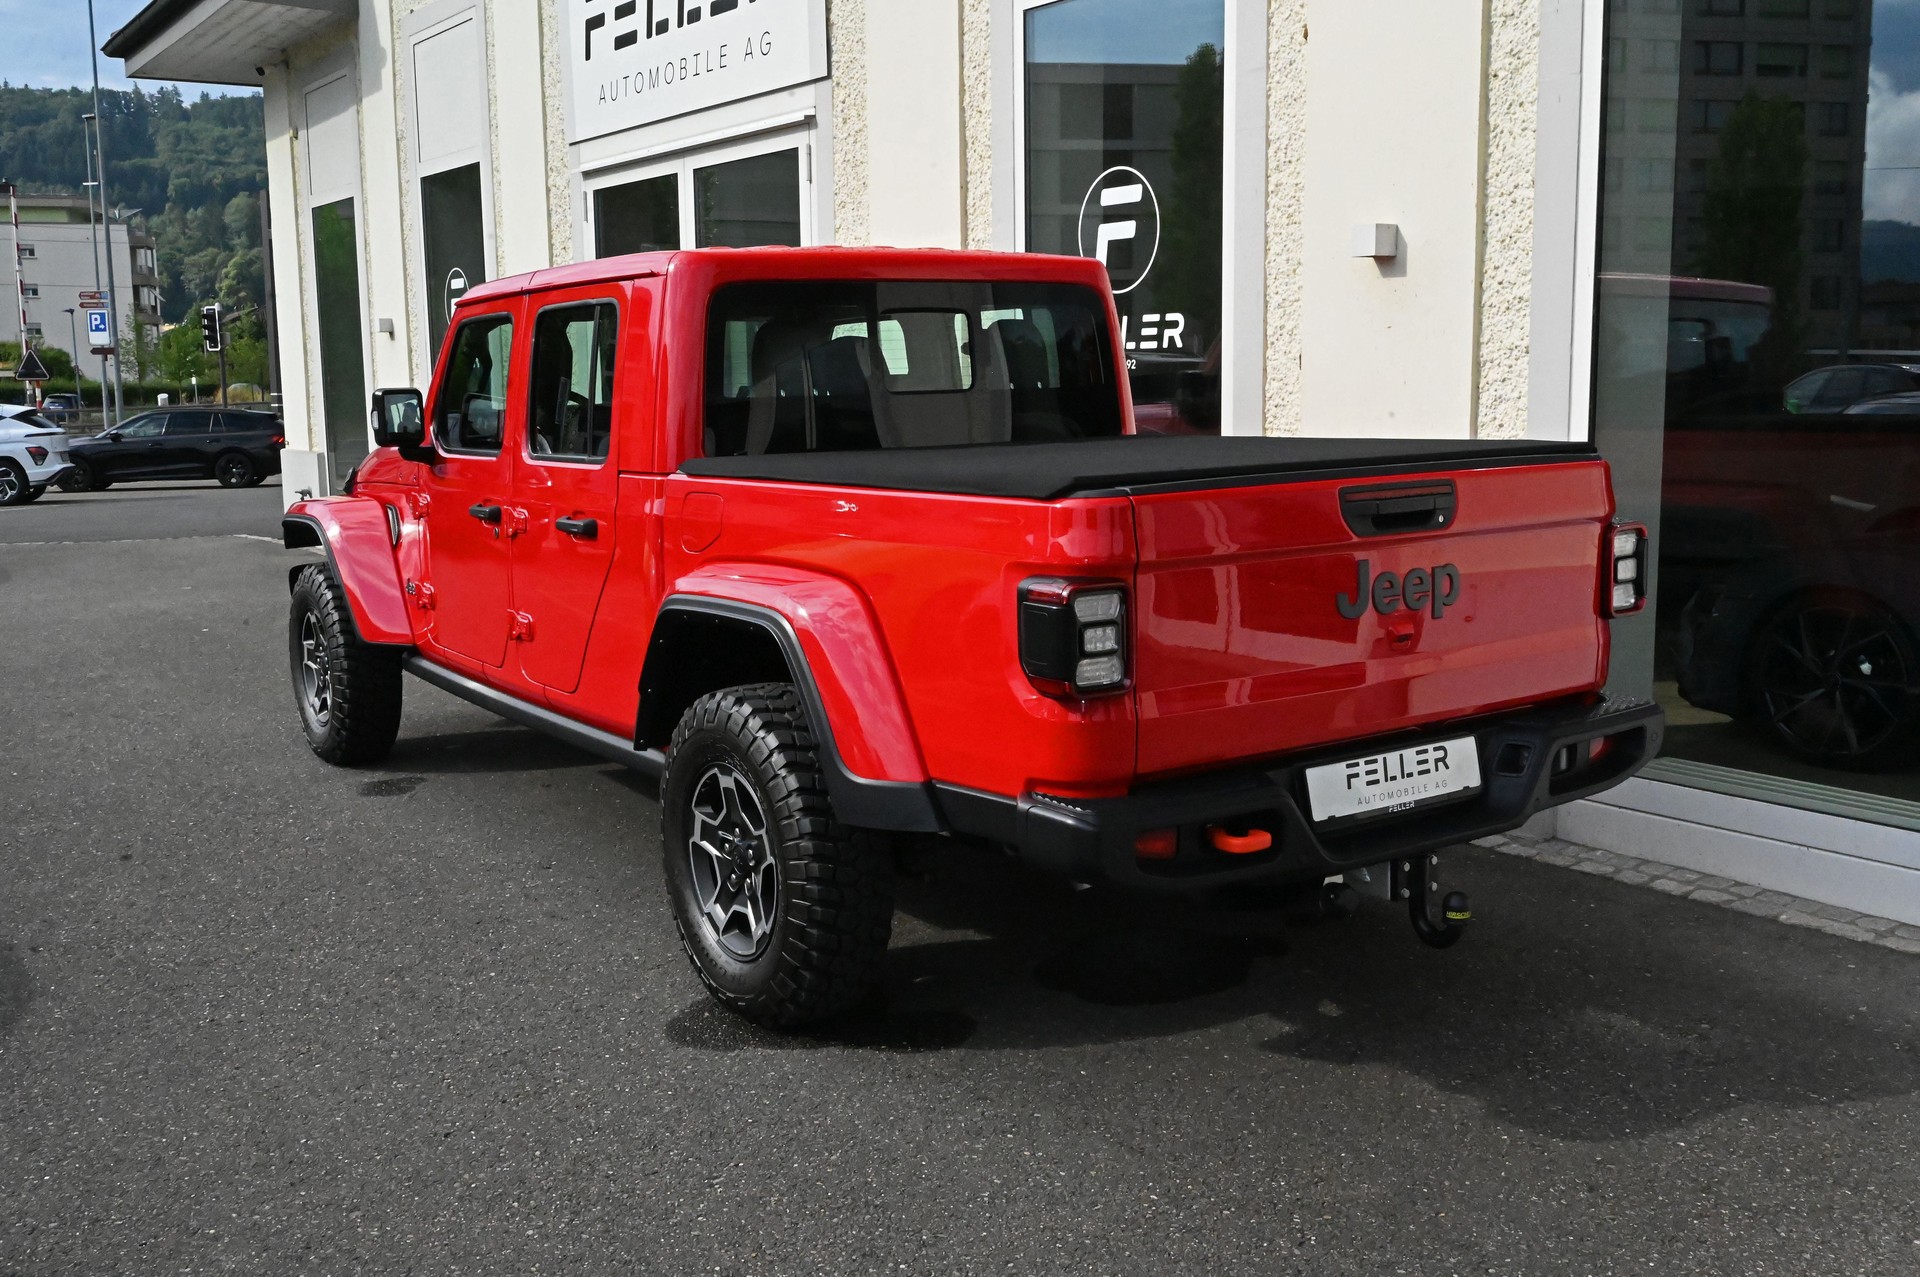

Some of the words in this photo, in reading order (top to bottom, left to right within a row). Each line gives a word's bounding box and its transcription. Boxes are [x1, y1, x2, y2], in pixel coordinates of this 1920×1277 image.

[599, 44, 728, 105] AUTOMOBILE
[744, 31, 772, 61] AG
[91, 314, 101, 330] P
[1121, 313, 1185, 349] LER
[1126, 359, 1136, 369] 92
[1335, 559, 1461, 620] Jeep
[1345, 745, 1450, 790] FELLER
[1357, 784, 1428, 806] AUTOMOBILE
[1435, 779, 1448, 789] AG
[1389, 800, 1415, 813] FELLER
